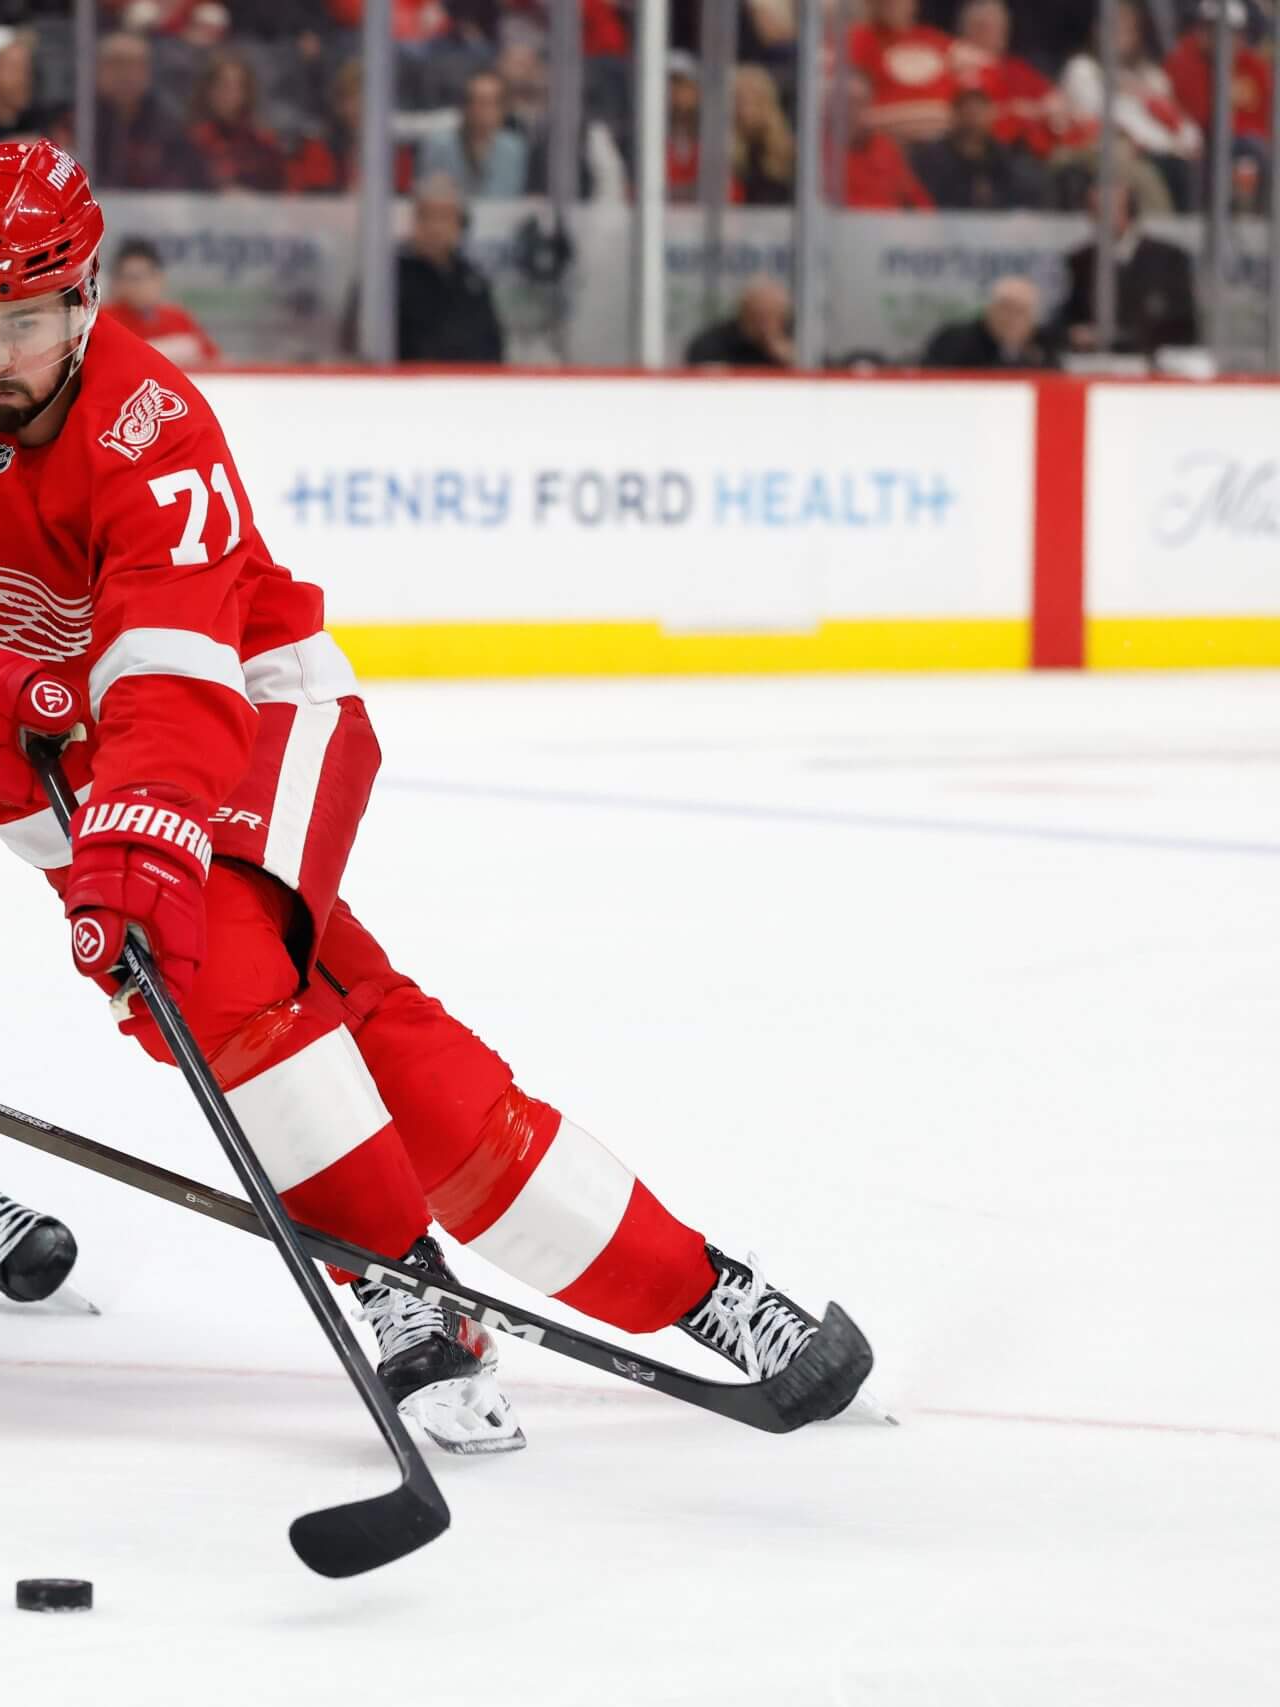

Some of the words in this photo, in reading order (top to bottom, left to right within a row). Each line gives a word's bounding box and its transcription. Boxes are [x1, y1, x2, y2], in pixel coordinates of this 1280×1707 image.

[147, 462, 241, 567] 71
[286, 470, 509, 527] HENRY
[534, 471, 693, 527] FORD
[713, 470, 957, 527] HEALTH
[79, 802, 212, 879] WARRIO
[142, 861, 180, 885] COVERT
[364, 1263, 546, 1345] CCM
